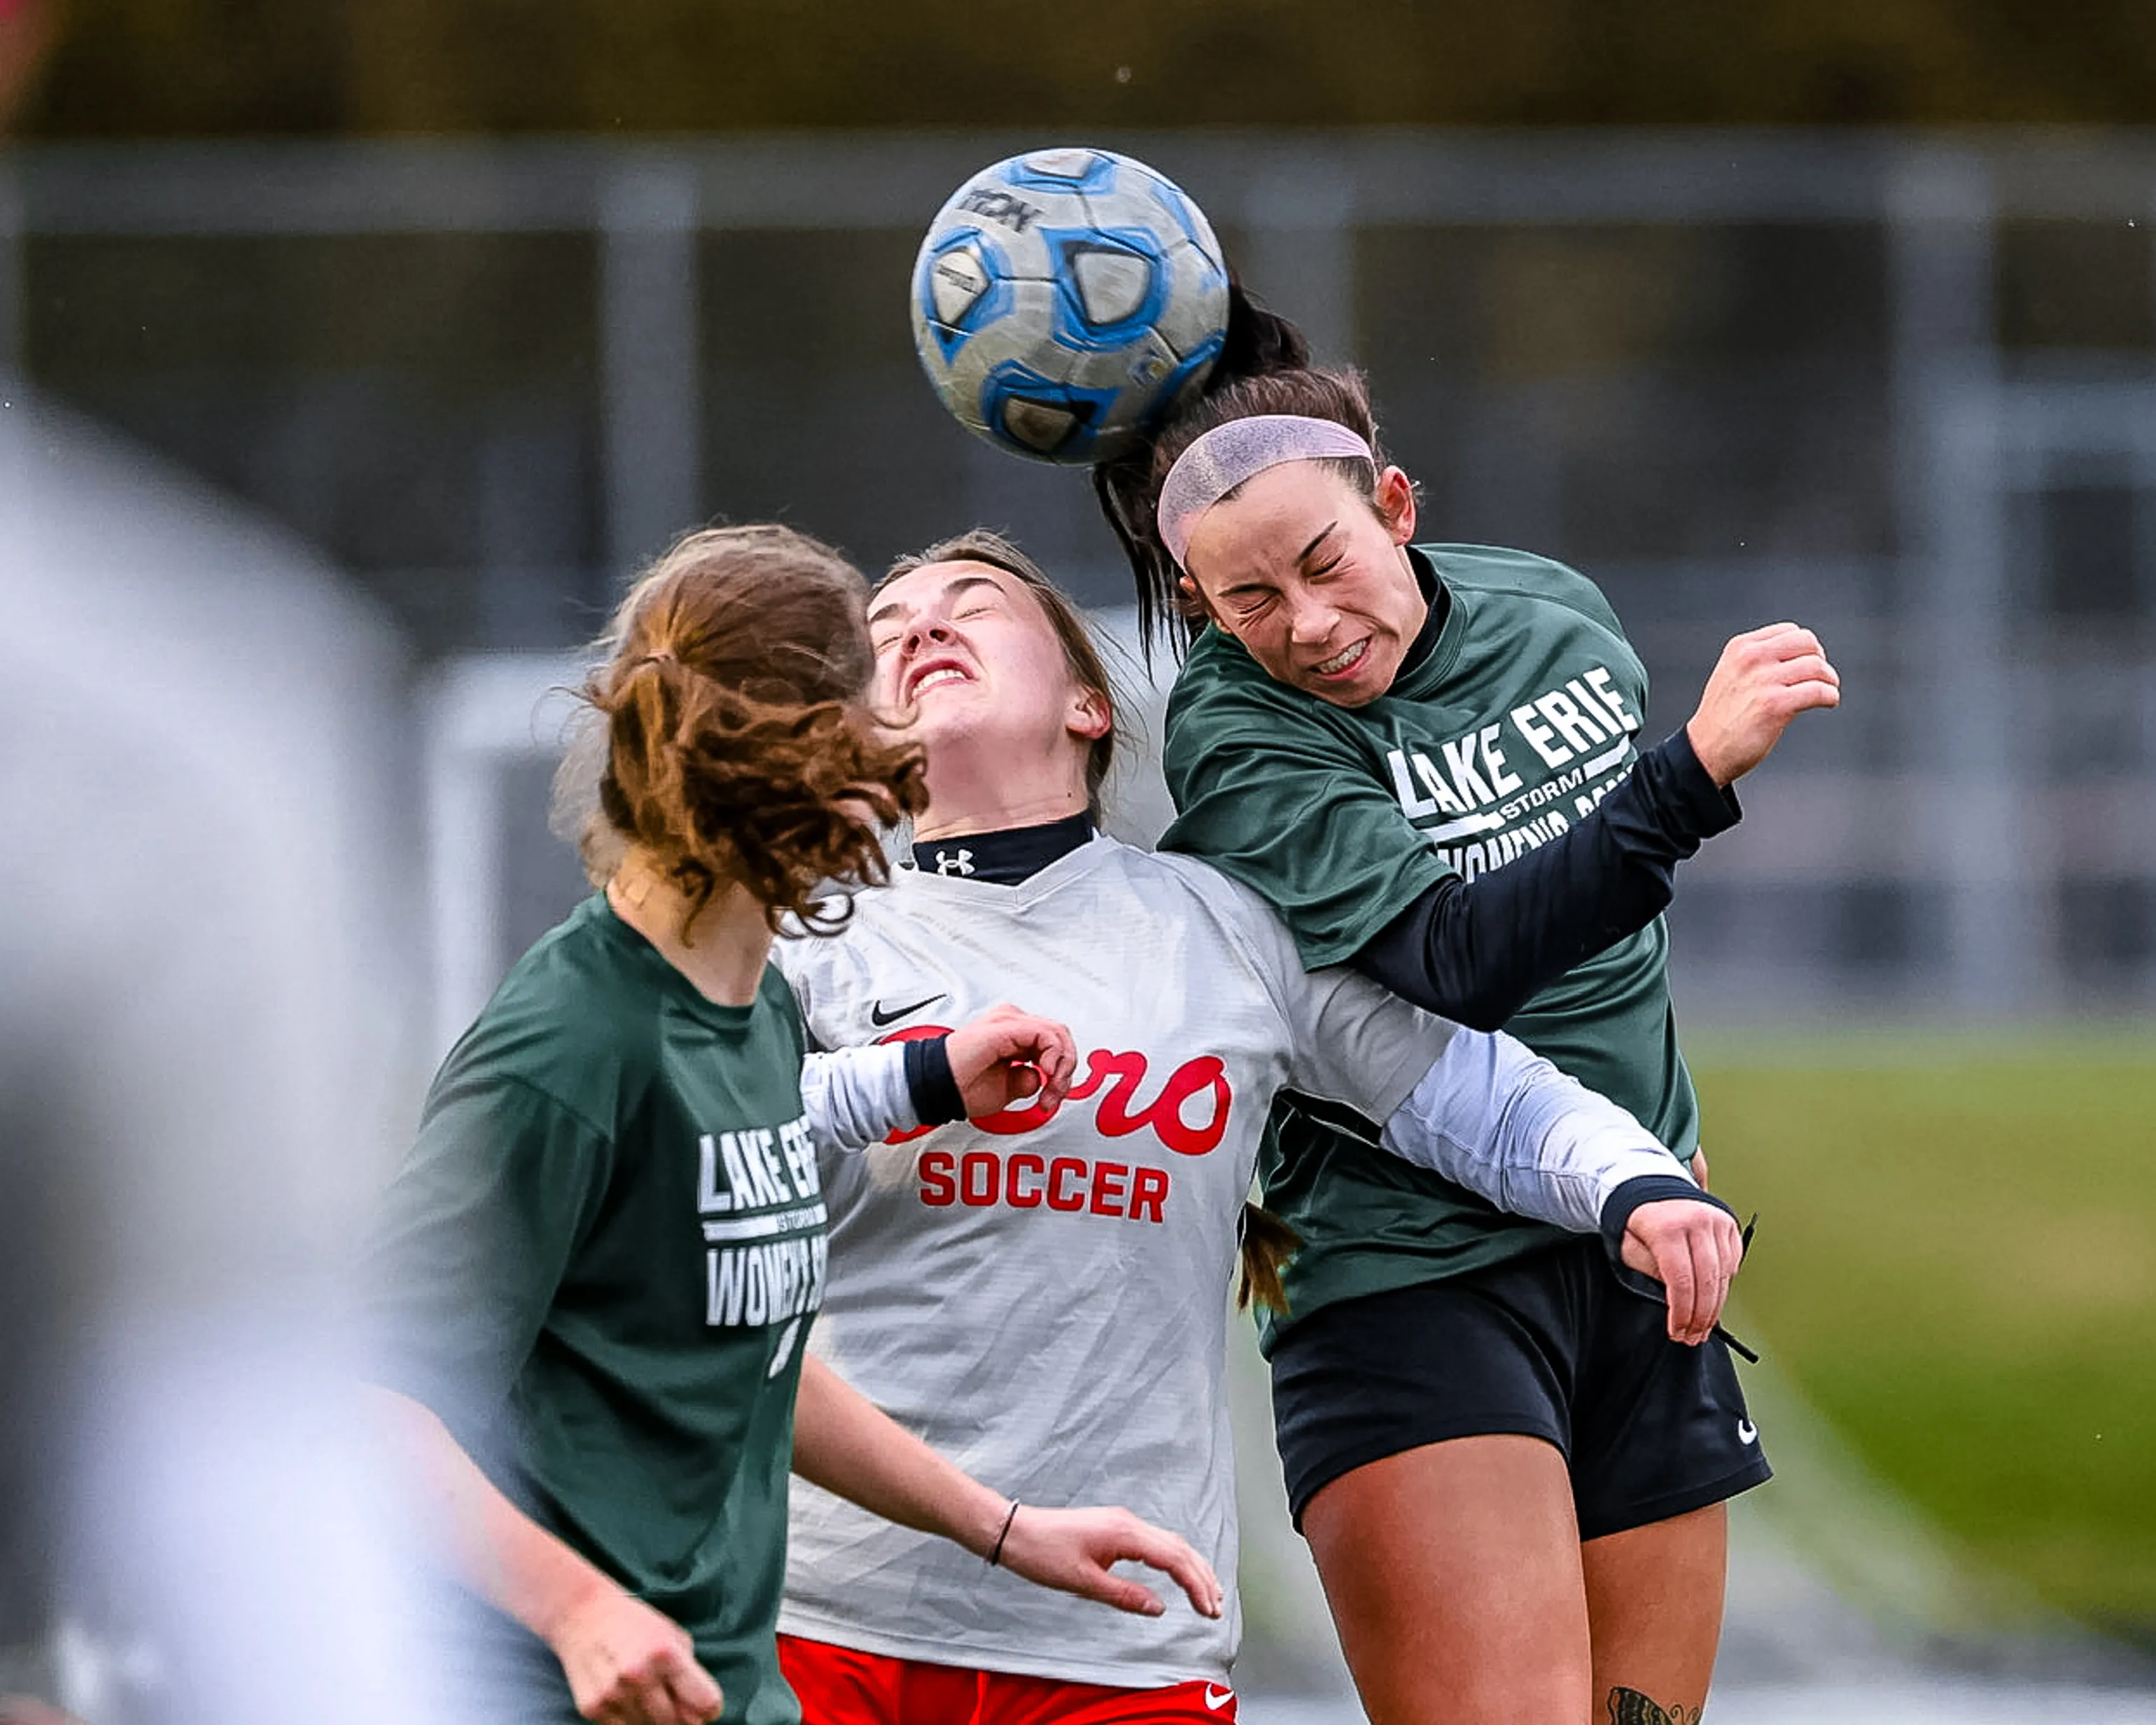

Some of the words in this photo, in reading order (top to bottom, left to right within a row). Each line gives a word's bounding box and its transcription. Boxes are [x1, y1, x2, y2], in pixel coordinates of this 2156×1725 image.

[1387, 722, 1523, 820] LAKE
[1511, 666, 1639, 769] ERIE
[1499, 767, 1583, 820] STORM
[698, 1128, 792, 1214] LAKE
[918, 1150, 1170, 1225] SOCCER
